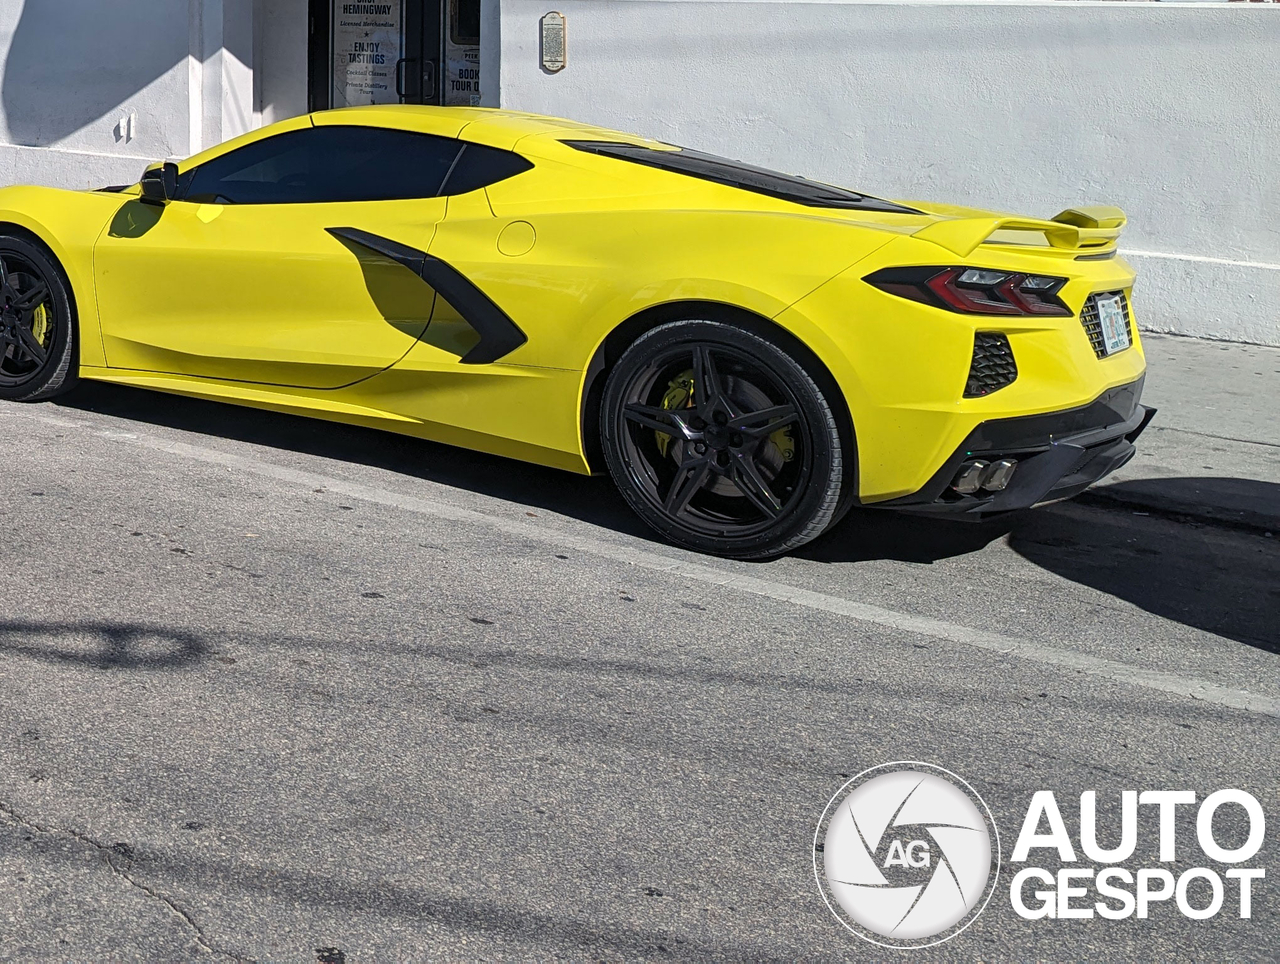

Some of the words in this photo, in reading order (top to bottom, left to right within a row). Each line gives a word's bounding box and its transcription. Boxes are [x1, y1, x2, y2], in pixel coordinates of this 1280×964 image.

[343, 4, 392, 15] HEMINGWAY
[354, 42, 380, 52] ENJOY
[348, 53, 385, 64] TASTINGS
[458, 68, 480, 80] BOOK
[451, 81, 472, 92] TOUR
